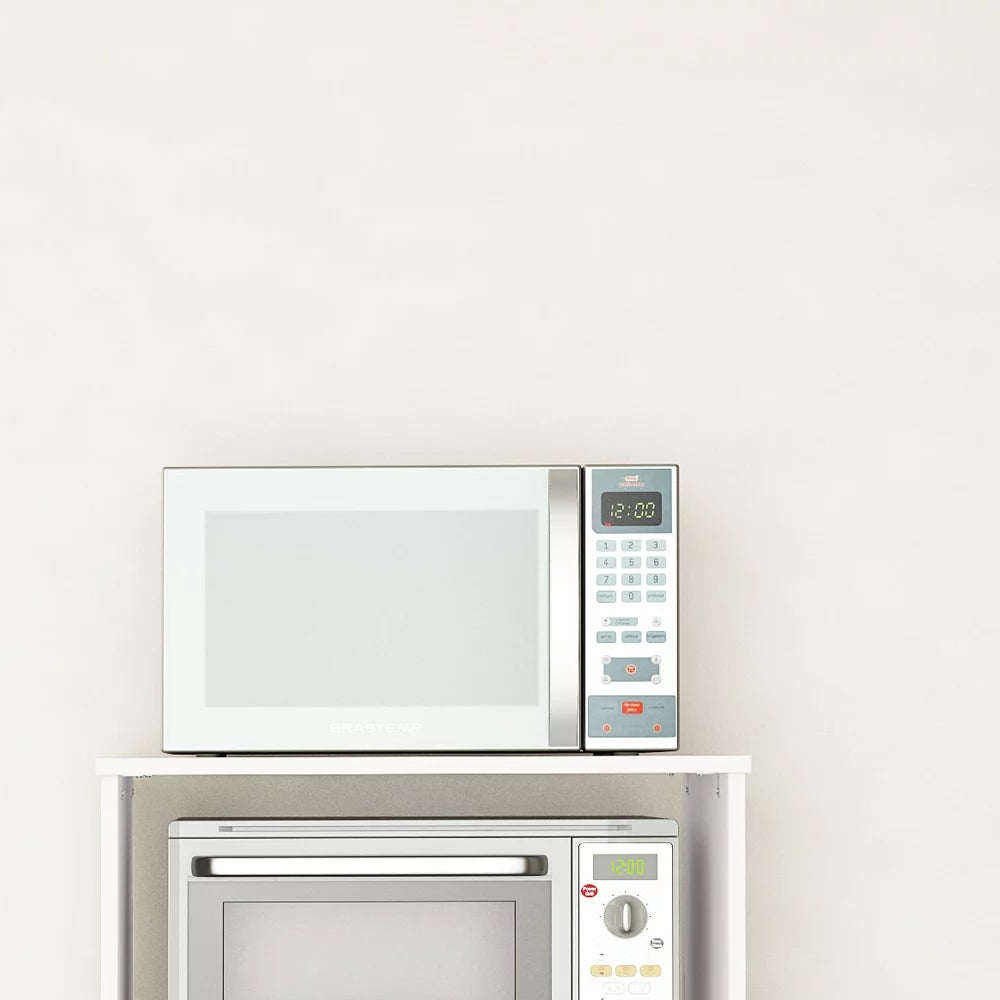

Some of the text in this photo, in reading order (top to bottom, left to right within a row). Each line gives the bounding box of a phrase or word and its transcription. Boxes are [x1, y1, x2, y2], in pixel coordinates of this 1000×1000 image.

[610, 501, 656, 519] 12:00
[328, 722, 423, 734] BRASTEMP
[611, 858, 645, 875] 12:00
